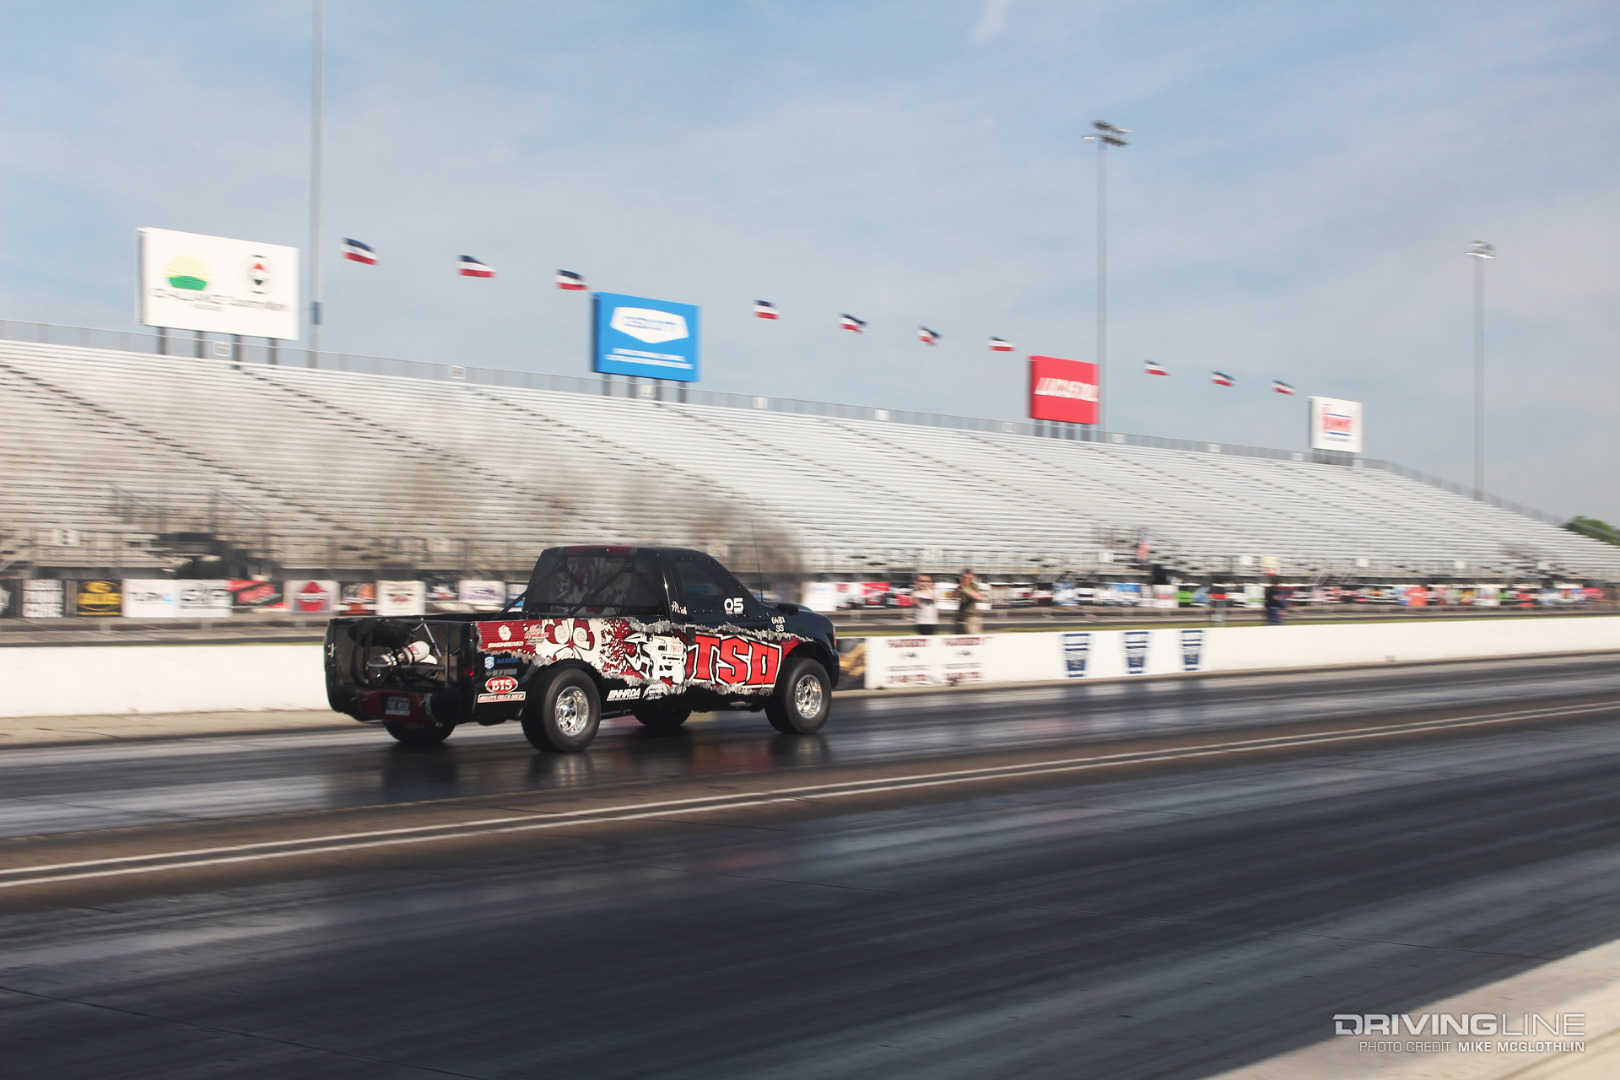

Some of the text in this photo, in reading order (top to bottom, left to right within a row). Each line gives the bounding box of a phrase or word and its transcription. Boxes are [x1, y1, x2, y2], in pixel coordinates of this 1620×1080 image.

[724, 597, 744, 614] 05
[689, 632, 782, 687] TSD
[491, 679, 513, 691] BTS
[610, 688, 641, 700] NHRDA
